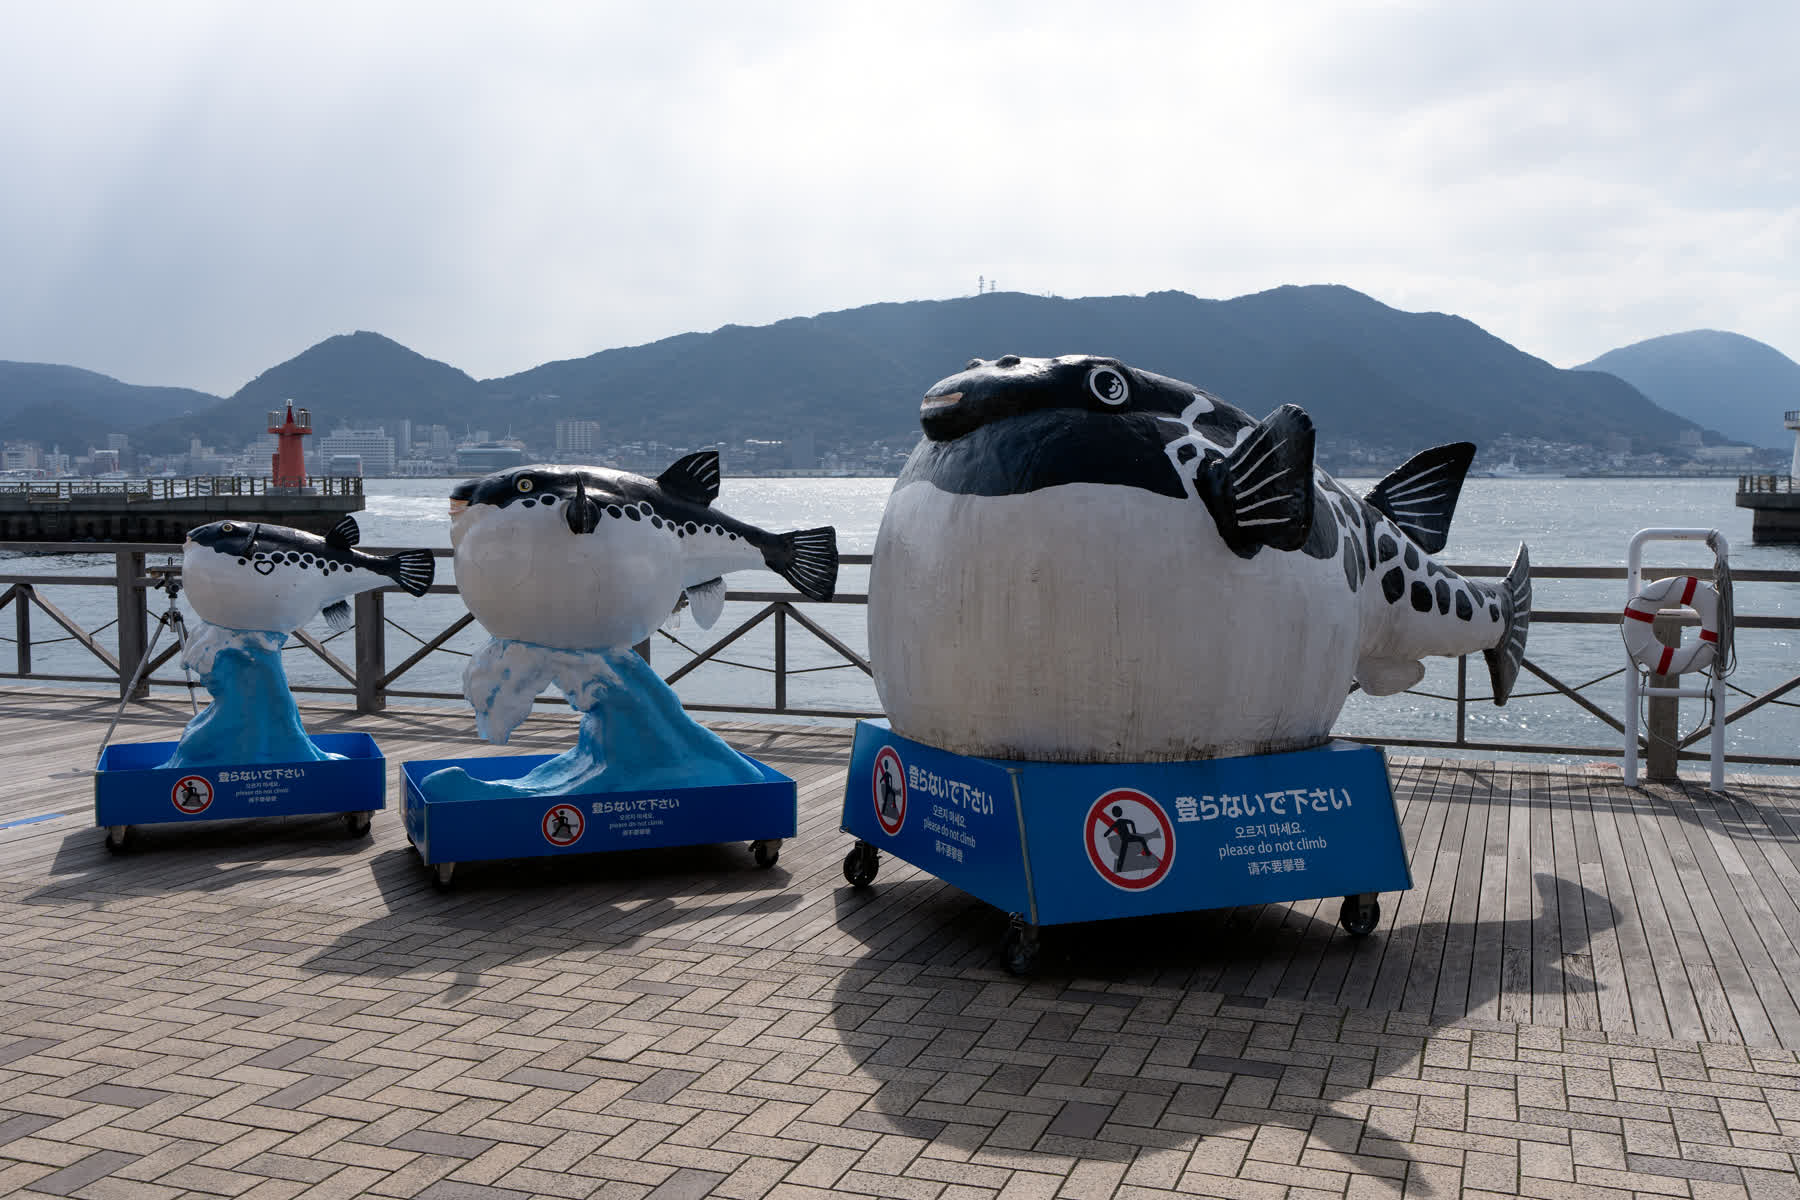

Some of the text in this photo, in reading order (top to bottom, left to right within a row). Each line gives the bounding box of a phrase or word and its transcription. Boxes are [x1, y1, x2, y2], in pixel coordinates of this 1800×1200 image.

[218, 768, 305, 783] 登らないで下さい
[909, 764, 994, 815] 登らないで下さい
[591, 798, 680, 814] 登らないで下さい
[1175, 788, 1352, 822] 登らないで下さい
[923, 817, 976, 848] please do not climb
[1235, 822, 1305, 839] 오르지 마세요.
[1218, 836, 1327, 860] please do not climb
[1248, 858, 1306, 875] 请不要攀登
